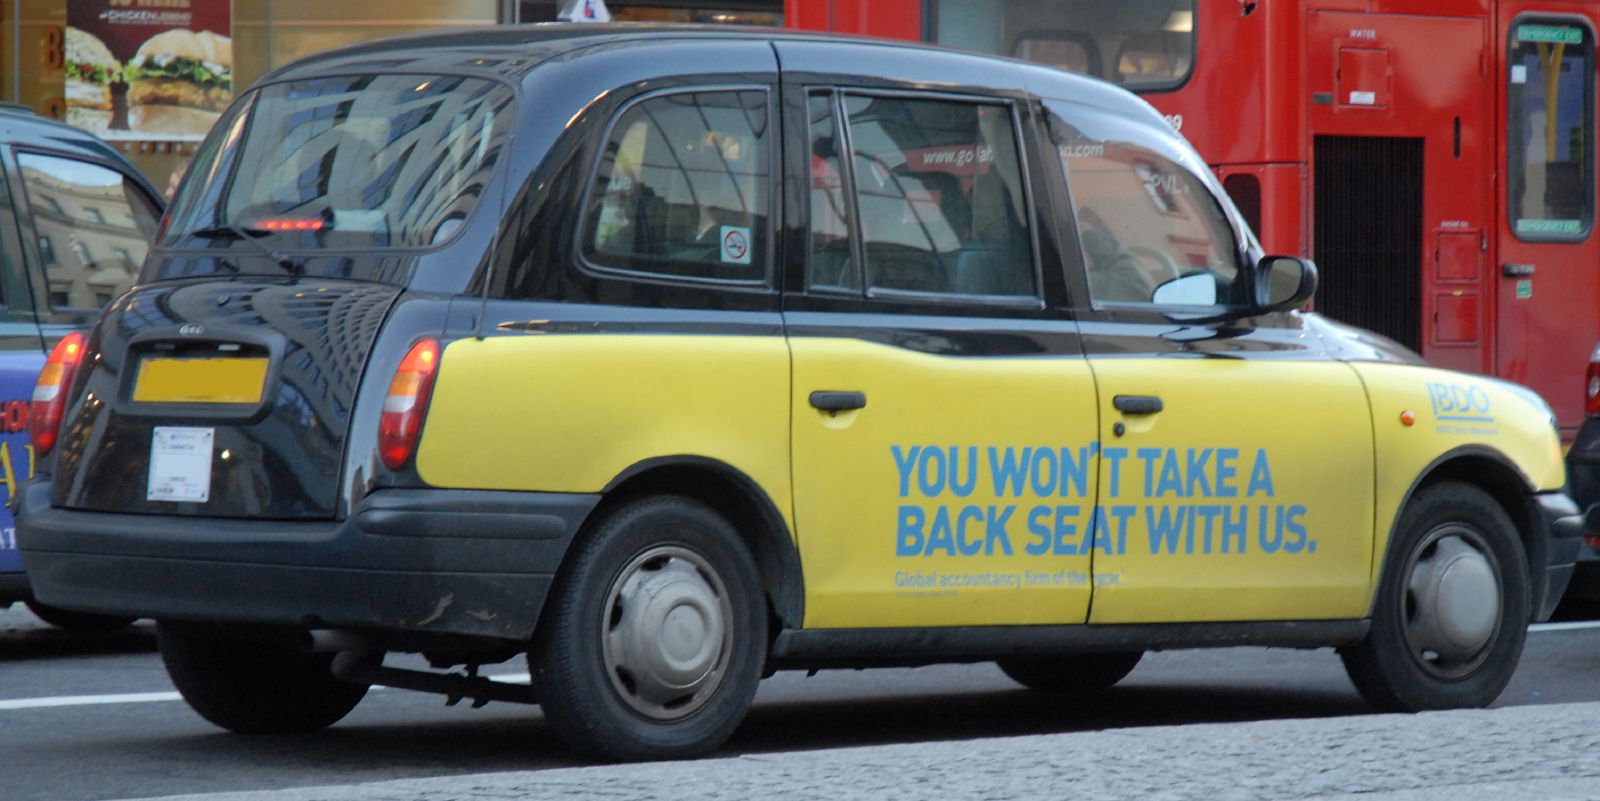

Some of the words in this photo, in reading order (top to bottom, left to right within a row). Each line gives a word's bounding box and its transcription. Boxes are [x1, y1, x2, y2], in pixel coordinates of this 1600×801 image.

[1350, 28, 1377, 40] WATER
[890, 445, 978, 498] YOU
[987, 441, 1128, 498] WON'T
[1137, 447, 1239, 497] TAKE
[1246, 447, 1275, 497] A
[896, 505, 1017, 556] BACK
[1024, 504, 1137, 556] SEAT
[1145, 504, 1248, 555] WITH
[1258, 504, 1317, 554] US.
[895, 571, 936, 587] Global
[940, 572, 1021, 590] accountancy
[1024, 570, 1049, 586] firm
[1051, 570, 1065, 586] of
[1067, 570, 1089, 586] the
